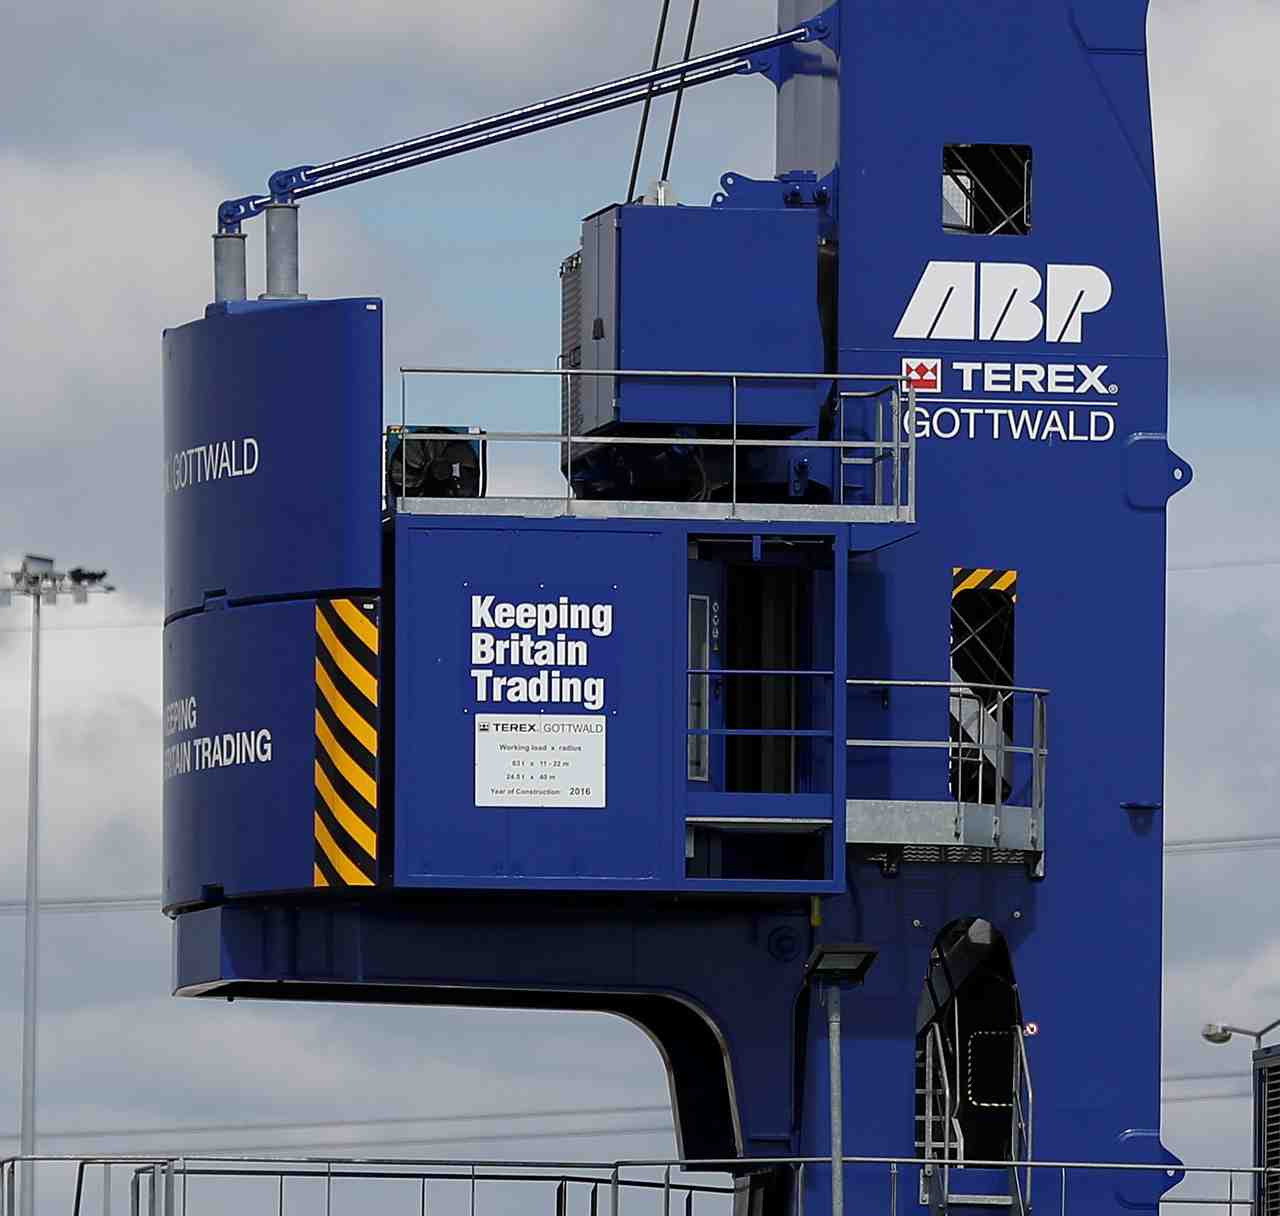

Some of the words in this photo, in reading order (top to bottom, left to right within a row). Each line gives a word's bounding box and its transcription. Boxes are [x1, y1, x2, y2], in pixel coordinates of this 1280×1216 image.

[893, 261, 1113, 343] ABP
[952, 361, 1109, 394] TEREX
[903, 407, 1115, 441] GOTTWALD
[173, 438, 259, 490] GOTTWALD
[471, 595, 613, 637] Keeping
[471, 632, 588, 666] Britain
[470, 669, 605, 711] Trading
[493, 723, 536, 732] TEREX
[543, 723, 604, 733] GOTTWALD
[193, 728, 272, 770] TRADING
[569, 786, 591, 796] 2016
